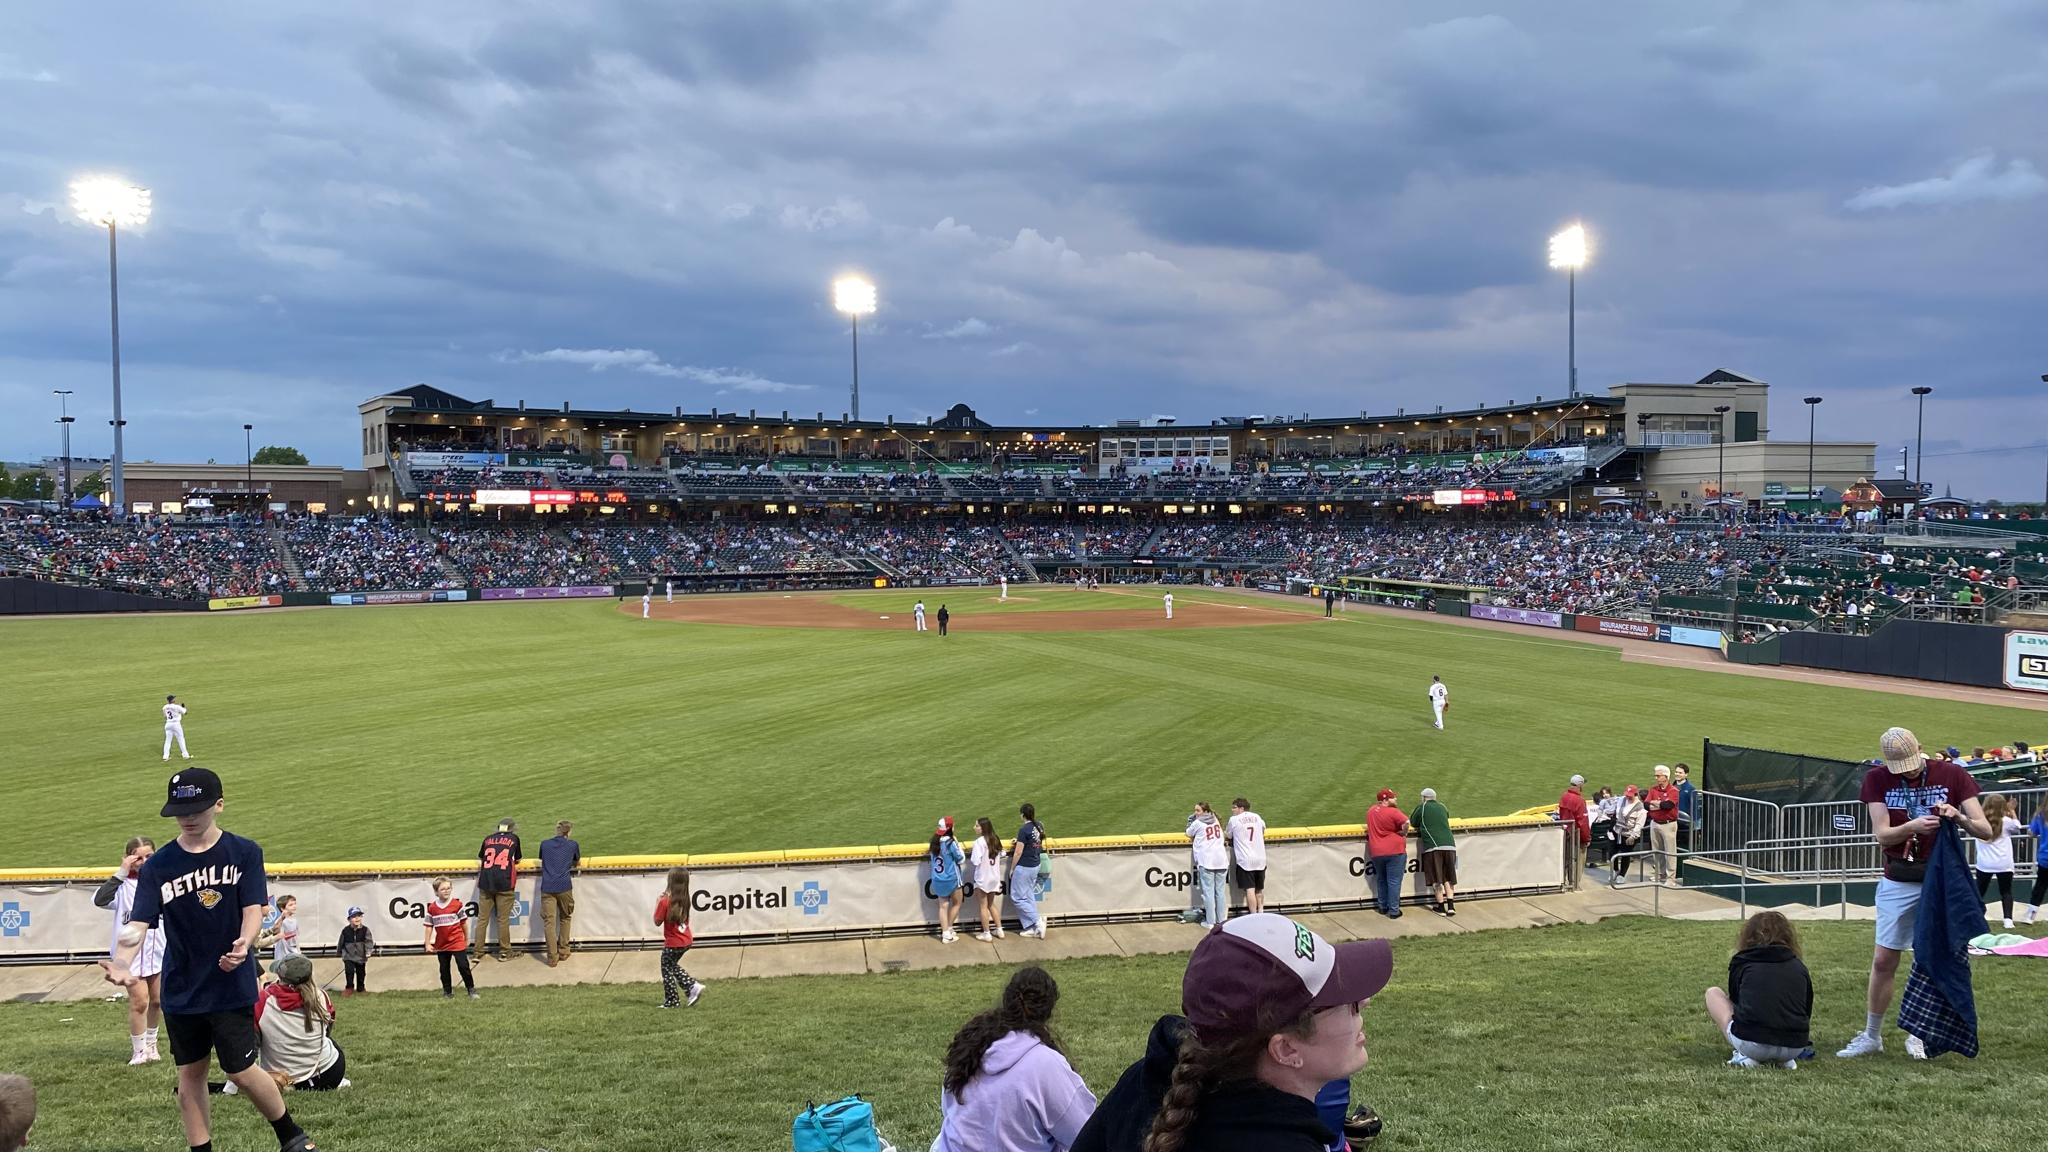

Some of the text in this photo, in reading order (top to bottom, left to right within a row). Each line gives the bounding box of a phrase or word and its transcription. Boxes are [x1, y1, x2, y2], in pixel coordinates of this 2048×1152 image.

[1600, 621, 1629, 631] INSURANCE
[167, 711, 173, 720] 3
[1205, 824, 1221, 841] 26
[1246, 826, 1254, 841] 7
[483, 848, 510, 870] 34
[934, 857, 944, 874] 3
[691, 886, 787, 915] Capital
